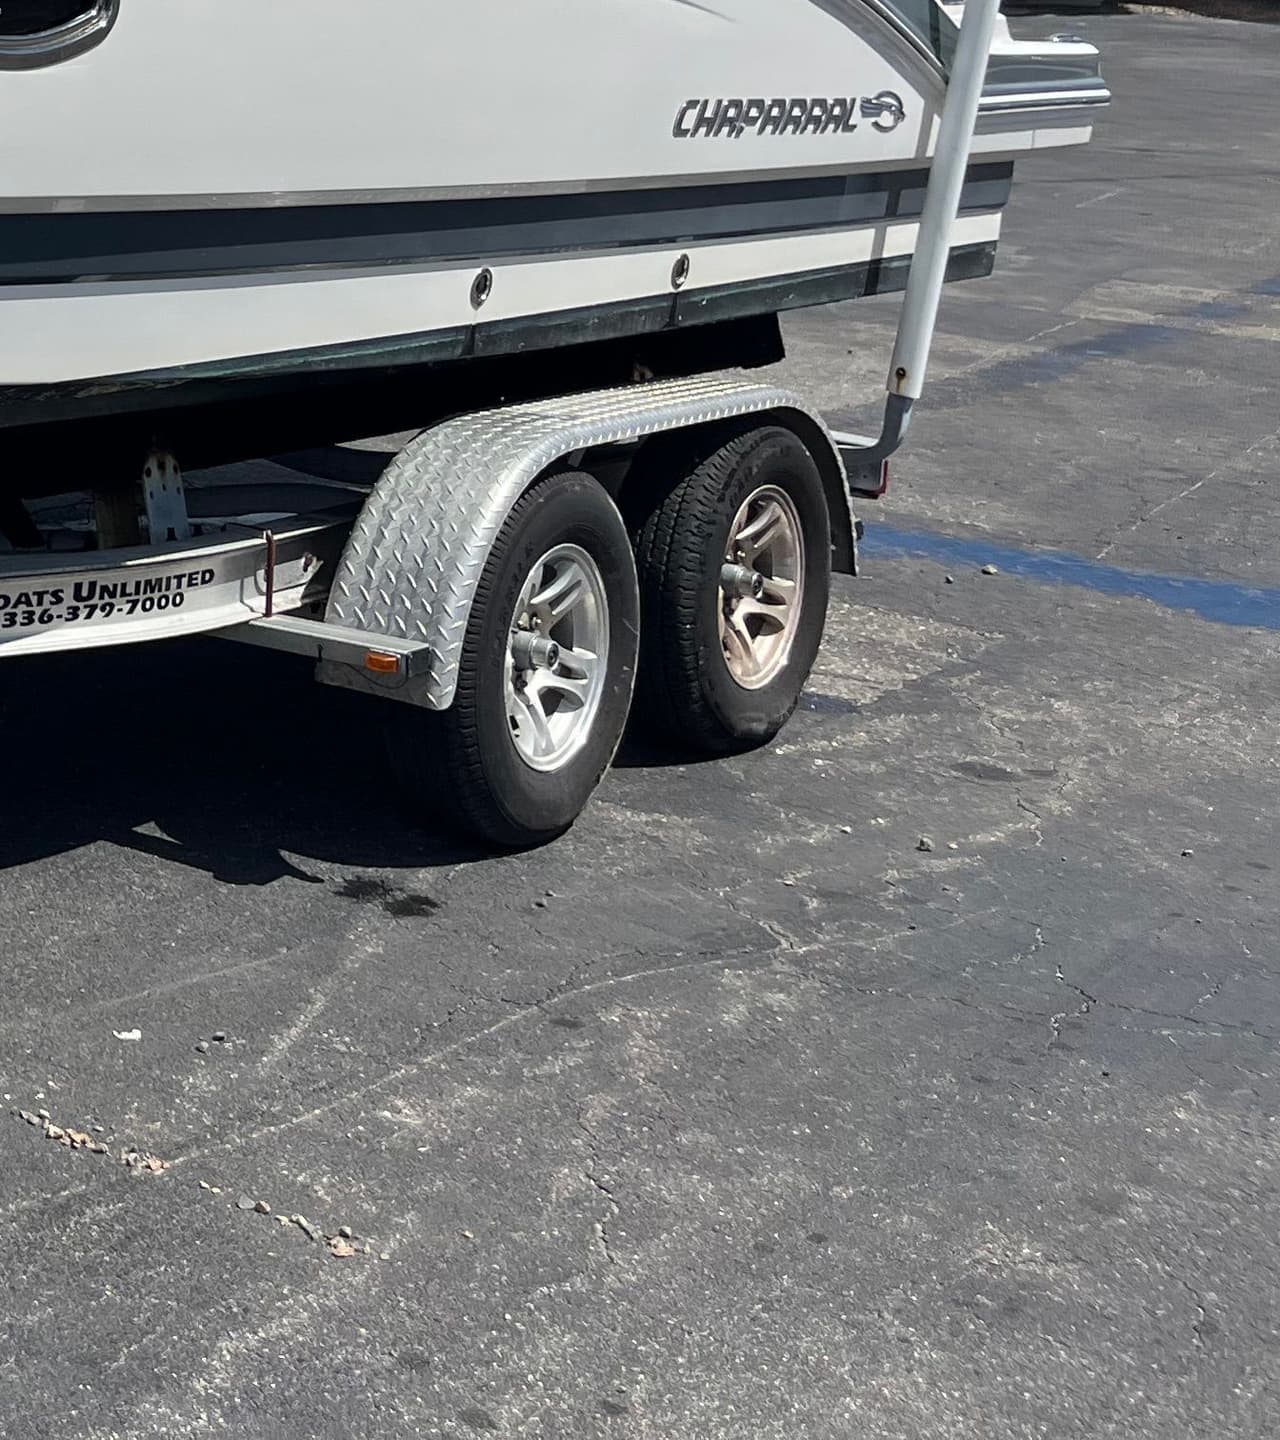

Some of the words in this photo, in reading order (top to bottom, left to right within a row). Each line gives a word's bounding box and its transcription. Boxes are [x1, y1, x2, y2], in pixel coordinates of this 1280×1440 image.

[672, 97, 857, 139] CHAPARRAL
[72, 568, 215, 604] UNLIMITED
[1, 591, 185, 629] 336-379-7000
